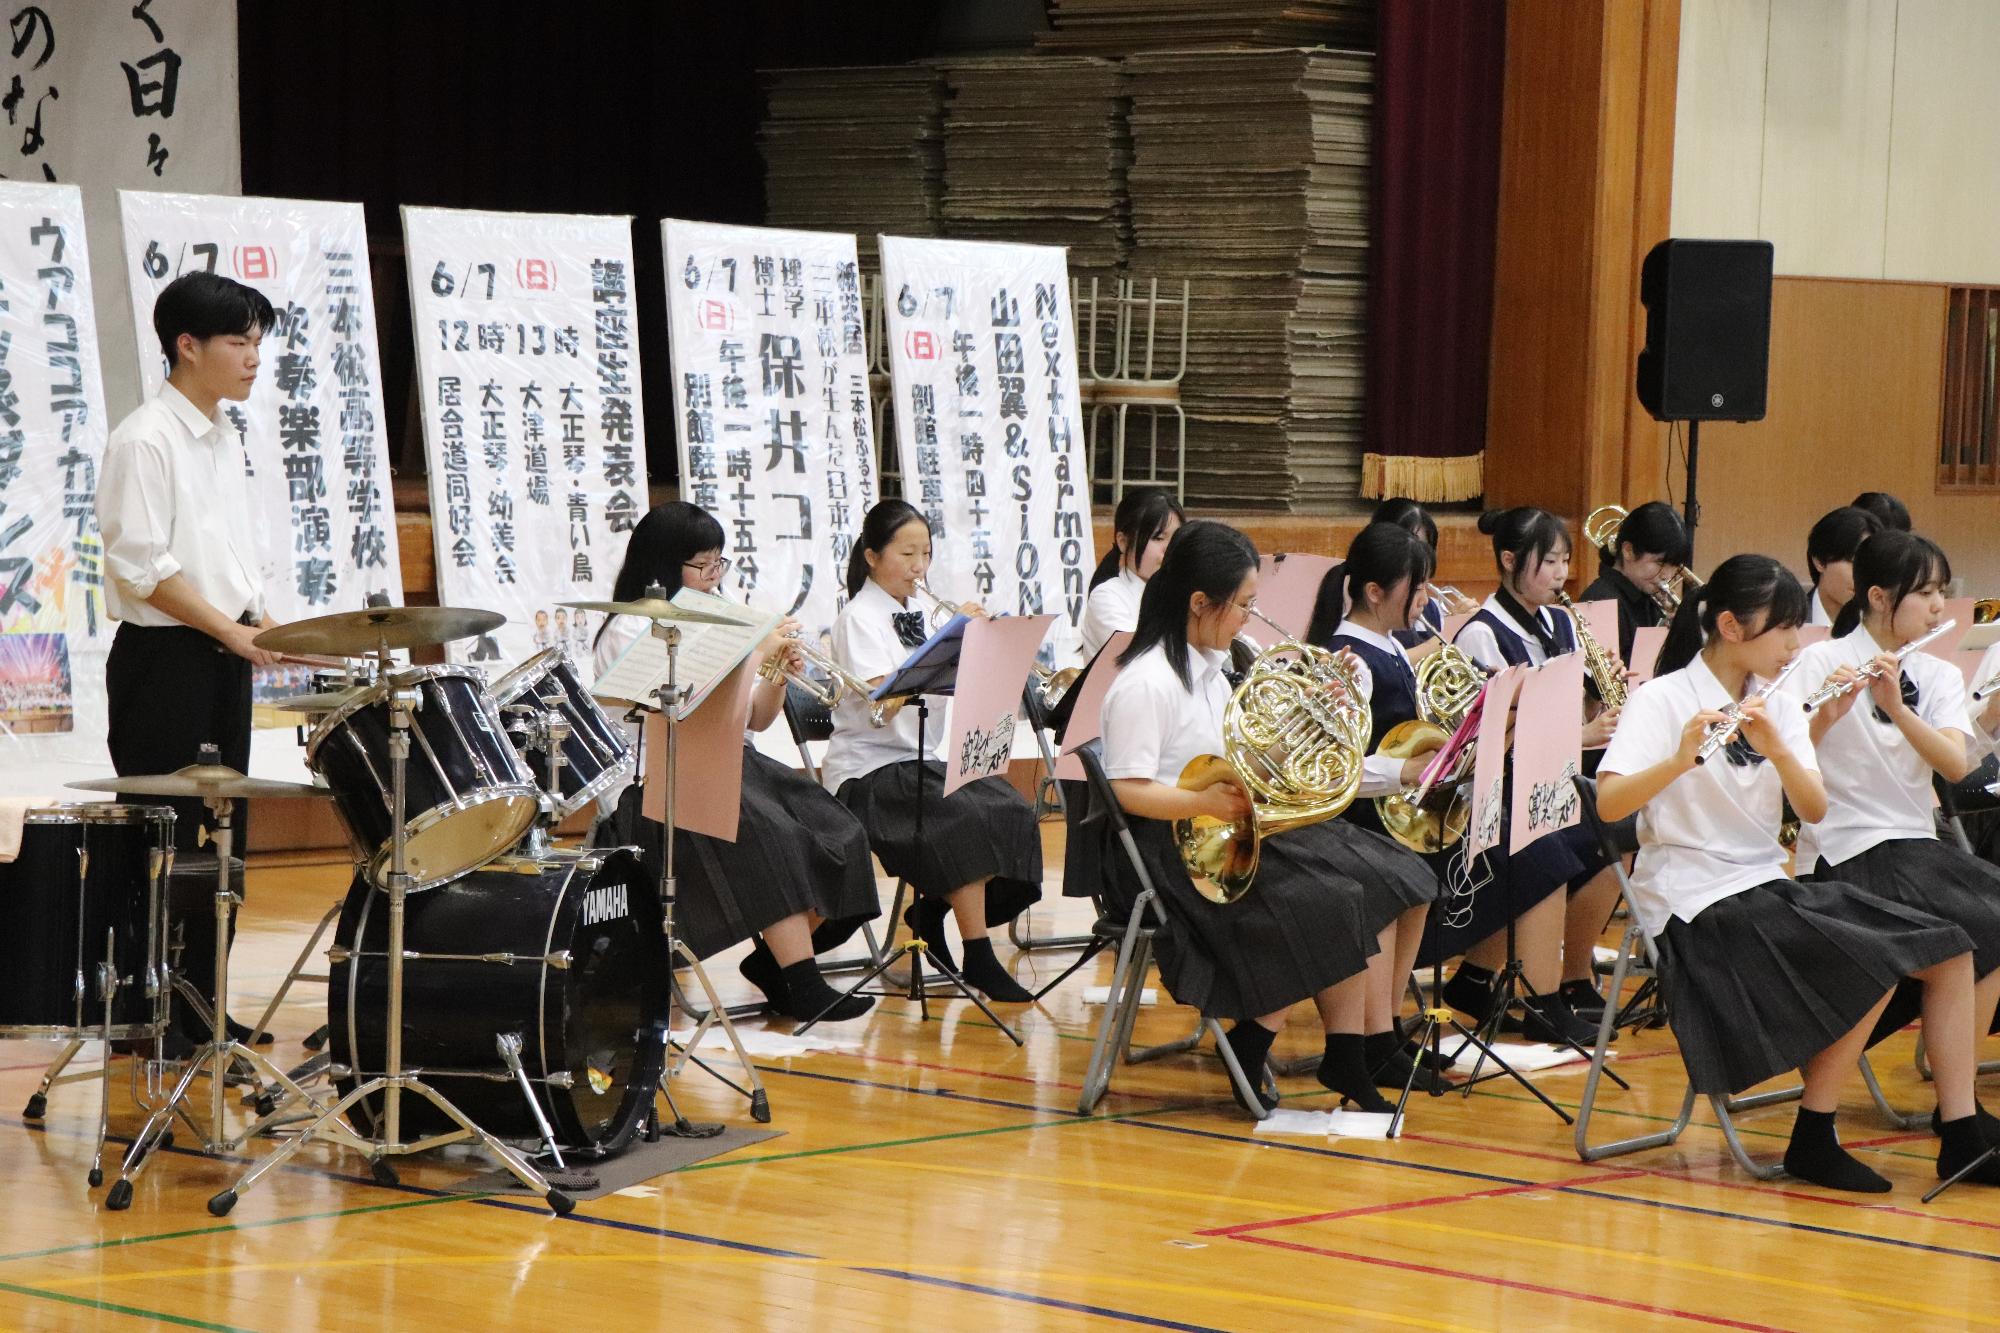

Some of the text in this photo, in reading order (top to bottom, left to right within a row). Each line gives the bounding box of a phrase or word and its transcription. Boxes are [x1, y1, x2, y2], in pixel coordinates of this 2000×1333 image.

[684, 254, 737, 293] 6/7
[897, 284, 953, 320] 6/7
[274, 300, 337, 606] 吹奏楽部演奏
[325, 252, 388, 569] 三本松高等学校
[438, 376, 477, 568] 居合道同好会
[479, 378, 516, 584] 大正琴・幼美会
[519, 379, 550, 506] 大津道場
[559, 381, 593, 583] 大正琴・青い鳥
[758, 333, 814, 616] 保井コノ
[911, 383, 945, 539] 別館駐車場
[583, 883, 628, 926] YAMAHA
